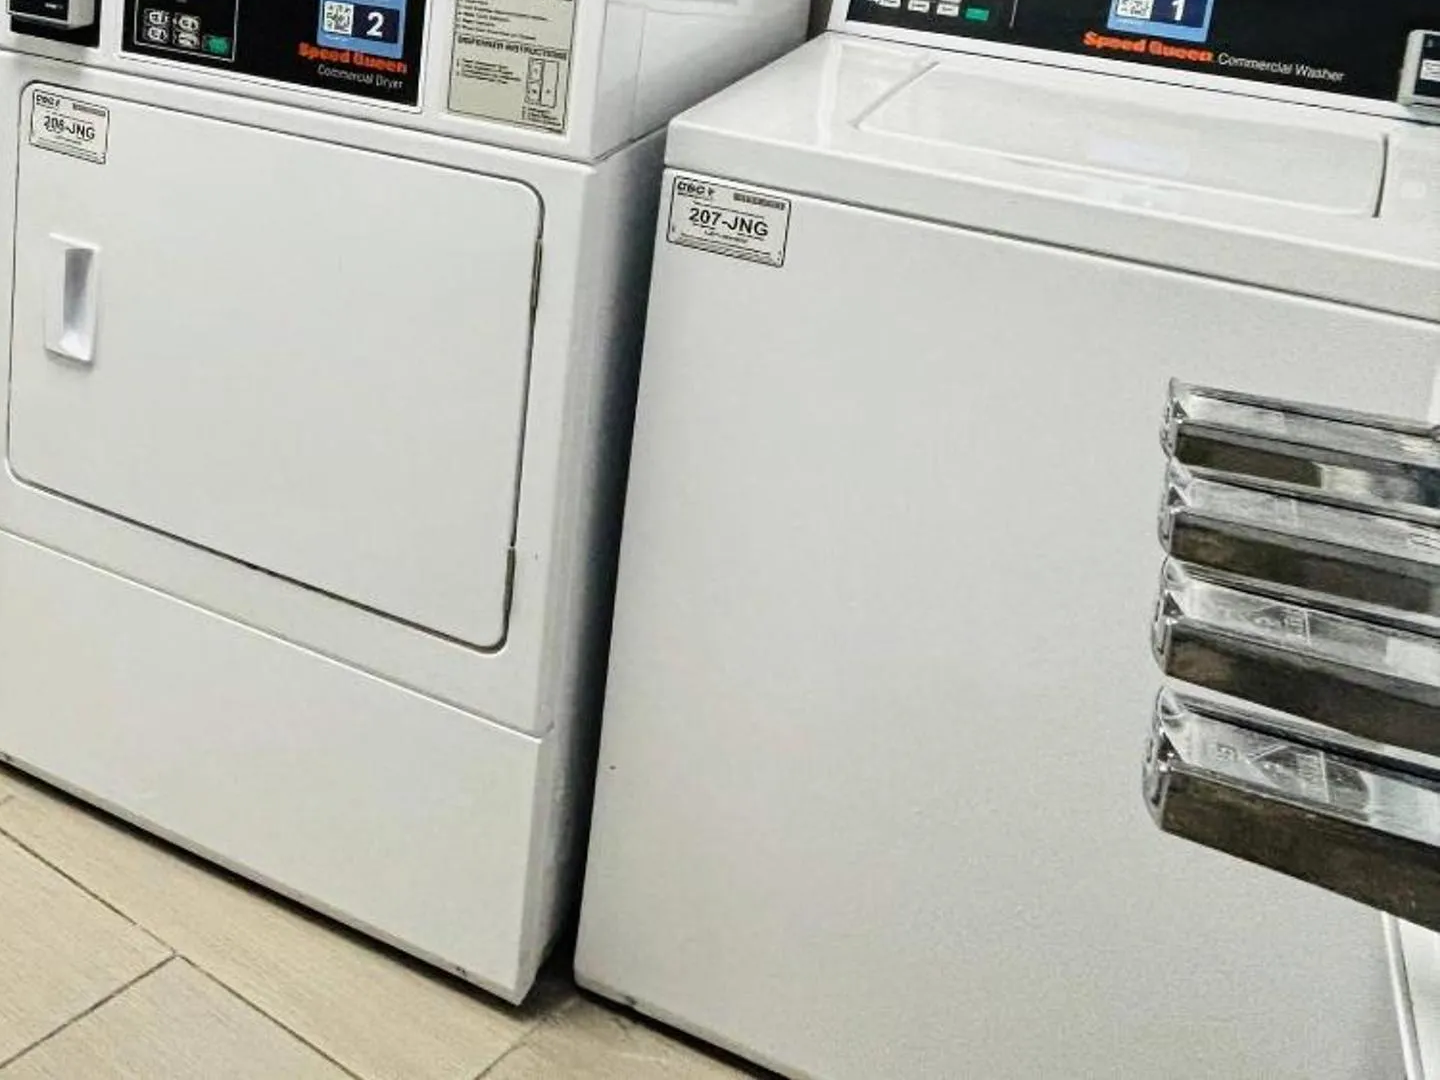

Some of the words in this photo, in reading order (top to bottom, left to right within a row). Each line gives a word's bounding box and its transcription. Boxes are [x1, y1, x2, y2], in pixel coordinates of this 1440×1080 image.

[366, 11, 385, 37] 2
[1082, 30, 1147, 53] Speed
[1217, 52, 1293, 75] Commercial
[1294, 63, 1346, 82] Washer
[689, 207, 769, 237] 207-JNG
